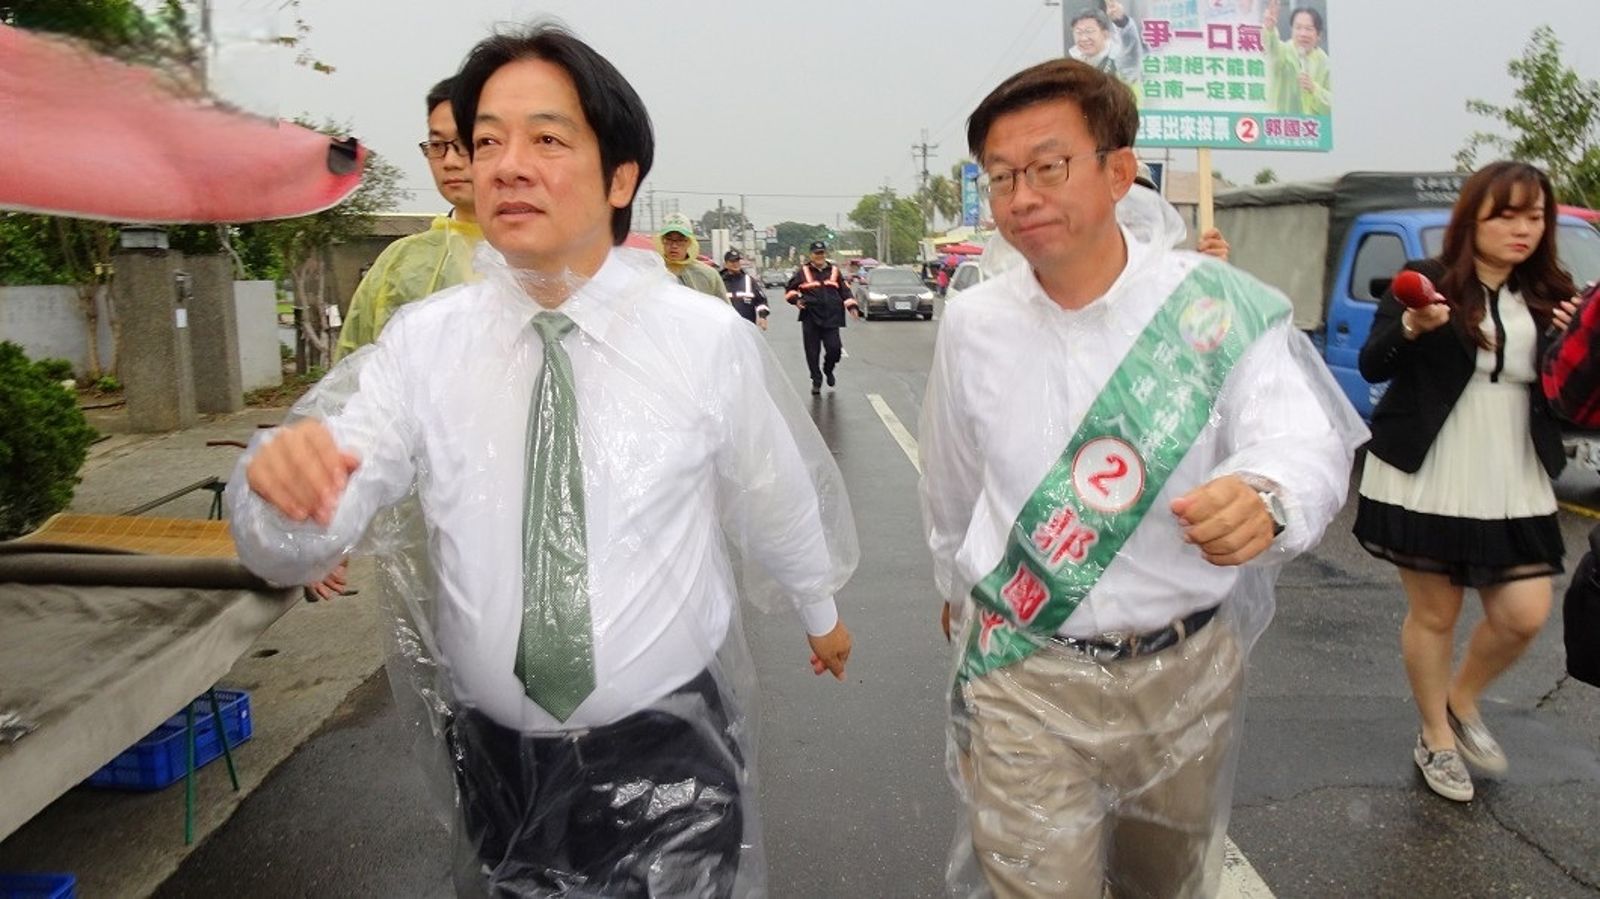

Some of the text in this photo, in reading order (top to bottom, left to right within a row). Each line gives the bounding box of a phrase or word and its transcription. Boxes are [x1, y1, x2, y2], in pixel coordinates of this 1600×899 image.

[1142, 20, 1265, 52] 爭一口氣
[1142, 55, 1265, 77] 台灣絕不能輸
[1142, 80, 1266, 101] 台南一定要贏
[1241, 120, 1254, 138] 2
[1264, 118, 1319, 138] 郭國文
[1088, 453, 1128, 497] 2
